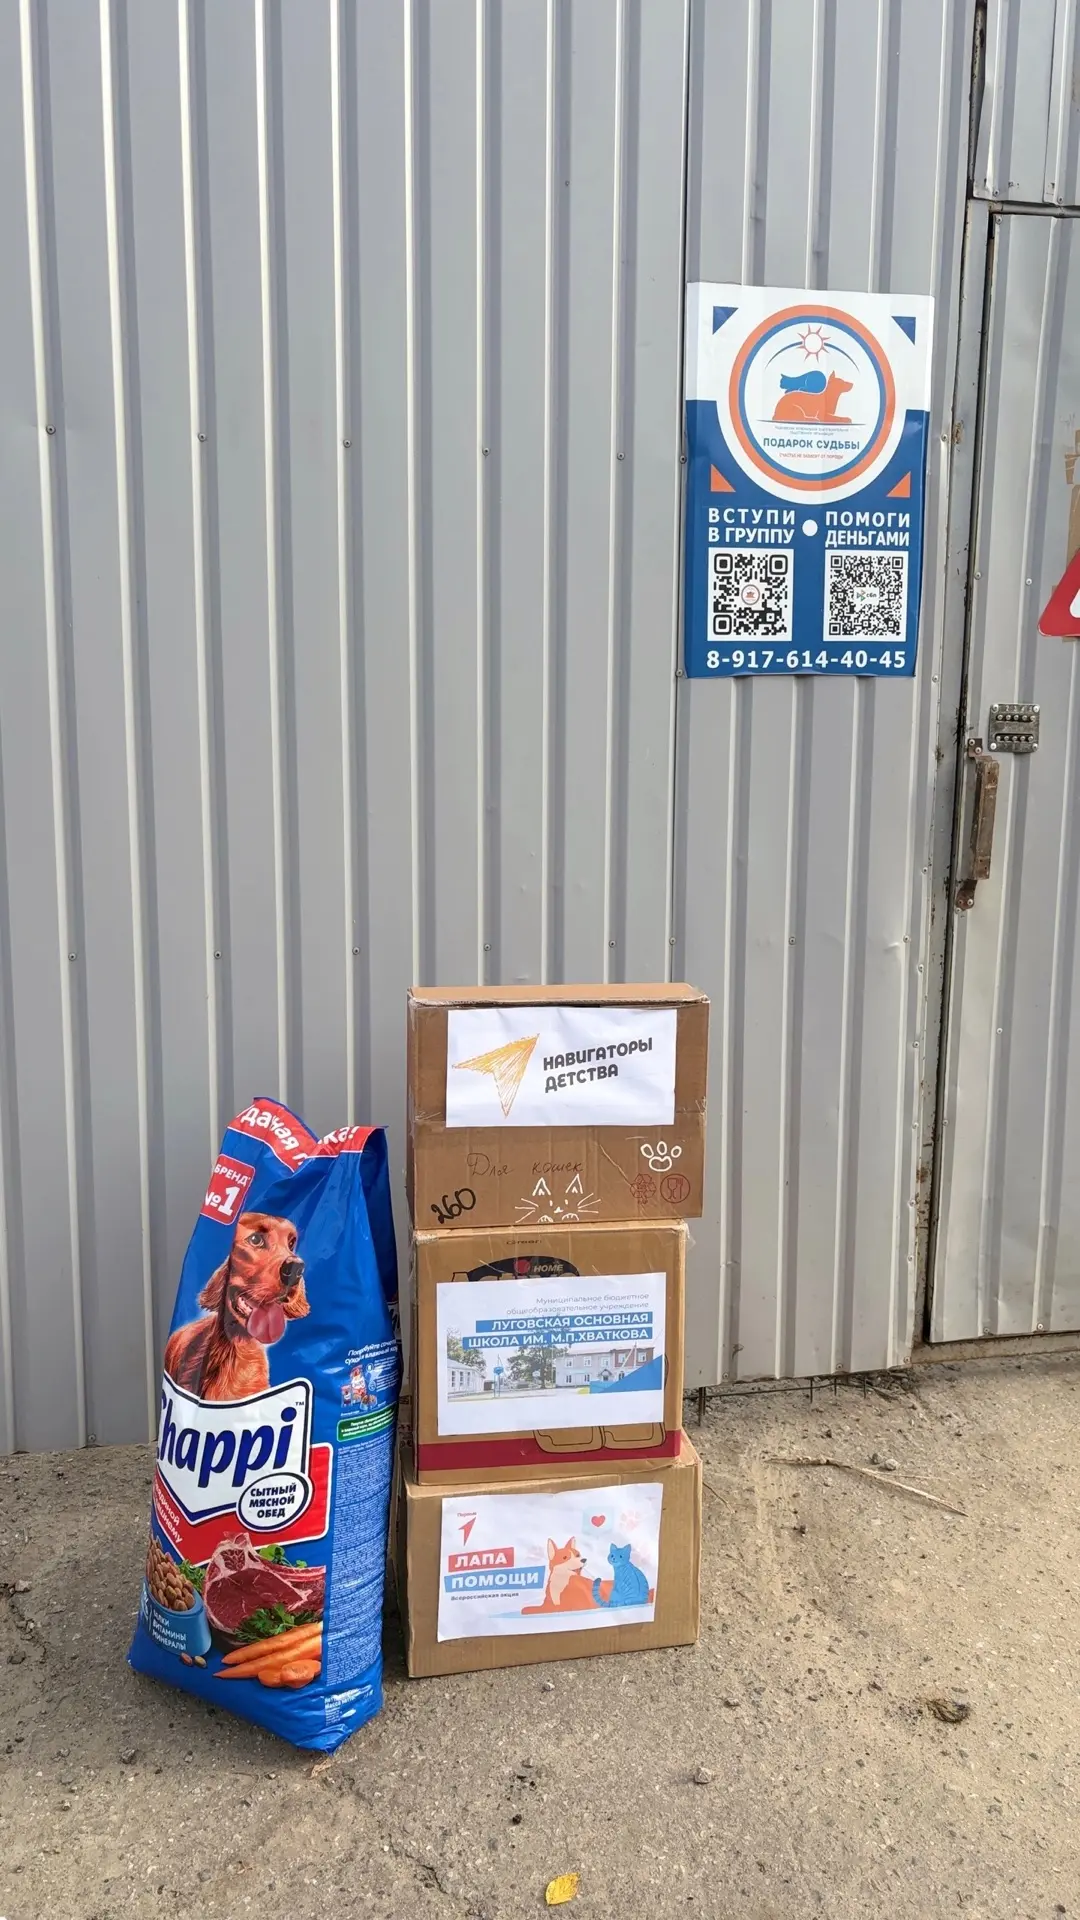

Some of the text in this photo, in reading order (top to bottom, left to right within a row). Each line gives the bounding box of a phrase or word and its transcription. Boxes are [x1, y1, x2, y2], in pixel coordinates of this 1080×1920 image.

[763, 438, 860, 450] ПОДАРОК СУДЬБЫ
[708, 508, 795, 525] ВСТУПИ
[825, 511, 910, 528] ПОМОГИ
[708, 527, 794, 544] В ГРУППУ
[825, 530, 910, 548] ДЕНЬГАМИ
[706, 650, 906, 668] 8-917-614-40-45
[543, 1037, 653, 1071] НАВИГАТОРЫ
[544, 1063, 619, 1093] ДЕТСТВА
[466, 1152, 514, 1176] Для
[431, 1188, 477, 1224] 260
[534, 1264, 564, 1272] HOME
[536, 1293, 650, 1305] Муниципальное бюджетное
[506, 1302, 649, 1316] общеобразовательное учреждение
[492, 1313, 649, 1330] ЛУГОВСКАЯ ОСНОВНАЯ
[468, 1329, 649, 1348] ШКОЛА ИМ. М.П.ХВАТКОВА
[157, 1388, 297, 1488] happi
[250, 1482, 297, 1498] СЫТНЫЙ
[248, 1495, 295, 1508] МЯСНОЙ
[257, 1508, 286, 1518] ОБЕД
[454, 1552, 508, 1568] ЛАПА
[452, 1572, 539, 1589] ПОМОЩИ
[451, 1593, 499, 1601] Всероссийская
[153, 1619, 186, 1641] ВИТАМИНЫ
[153, 1629, 186, 1650] МИНЕРАЛЫ
